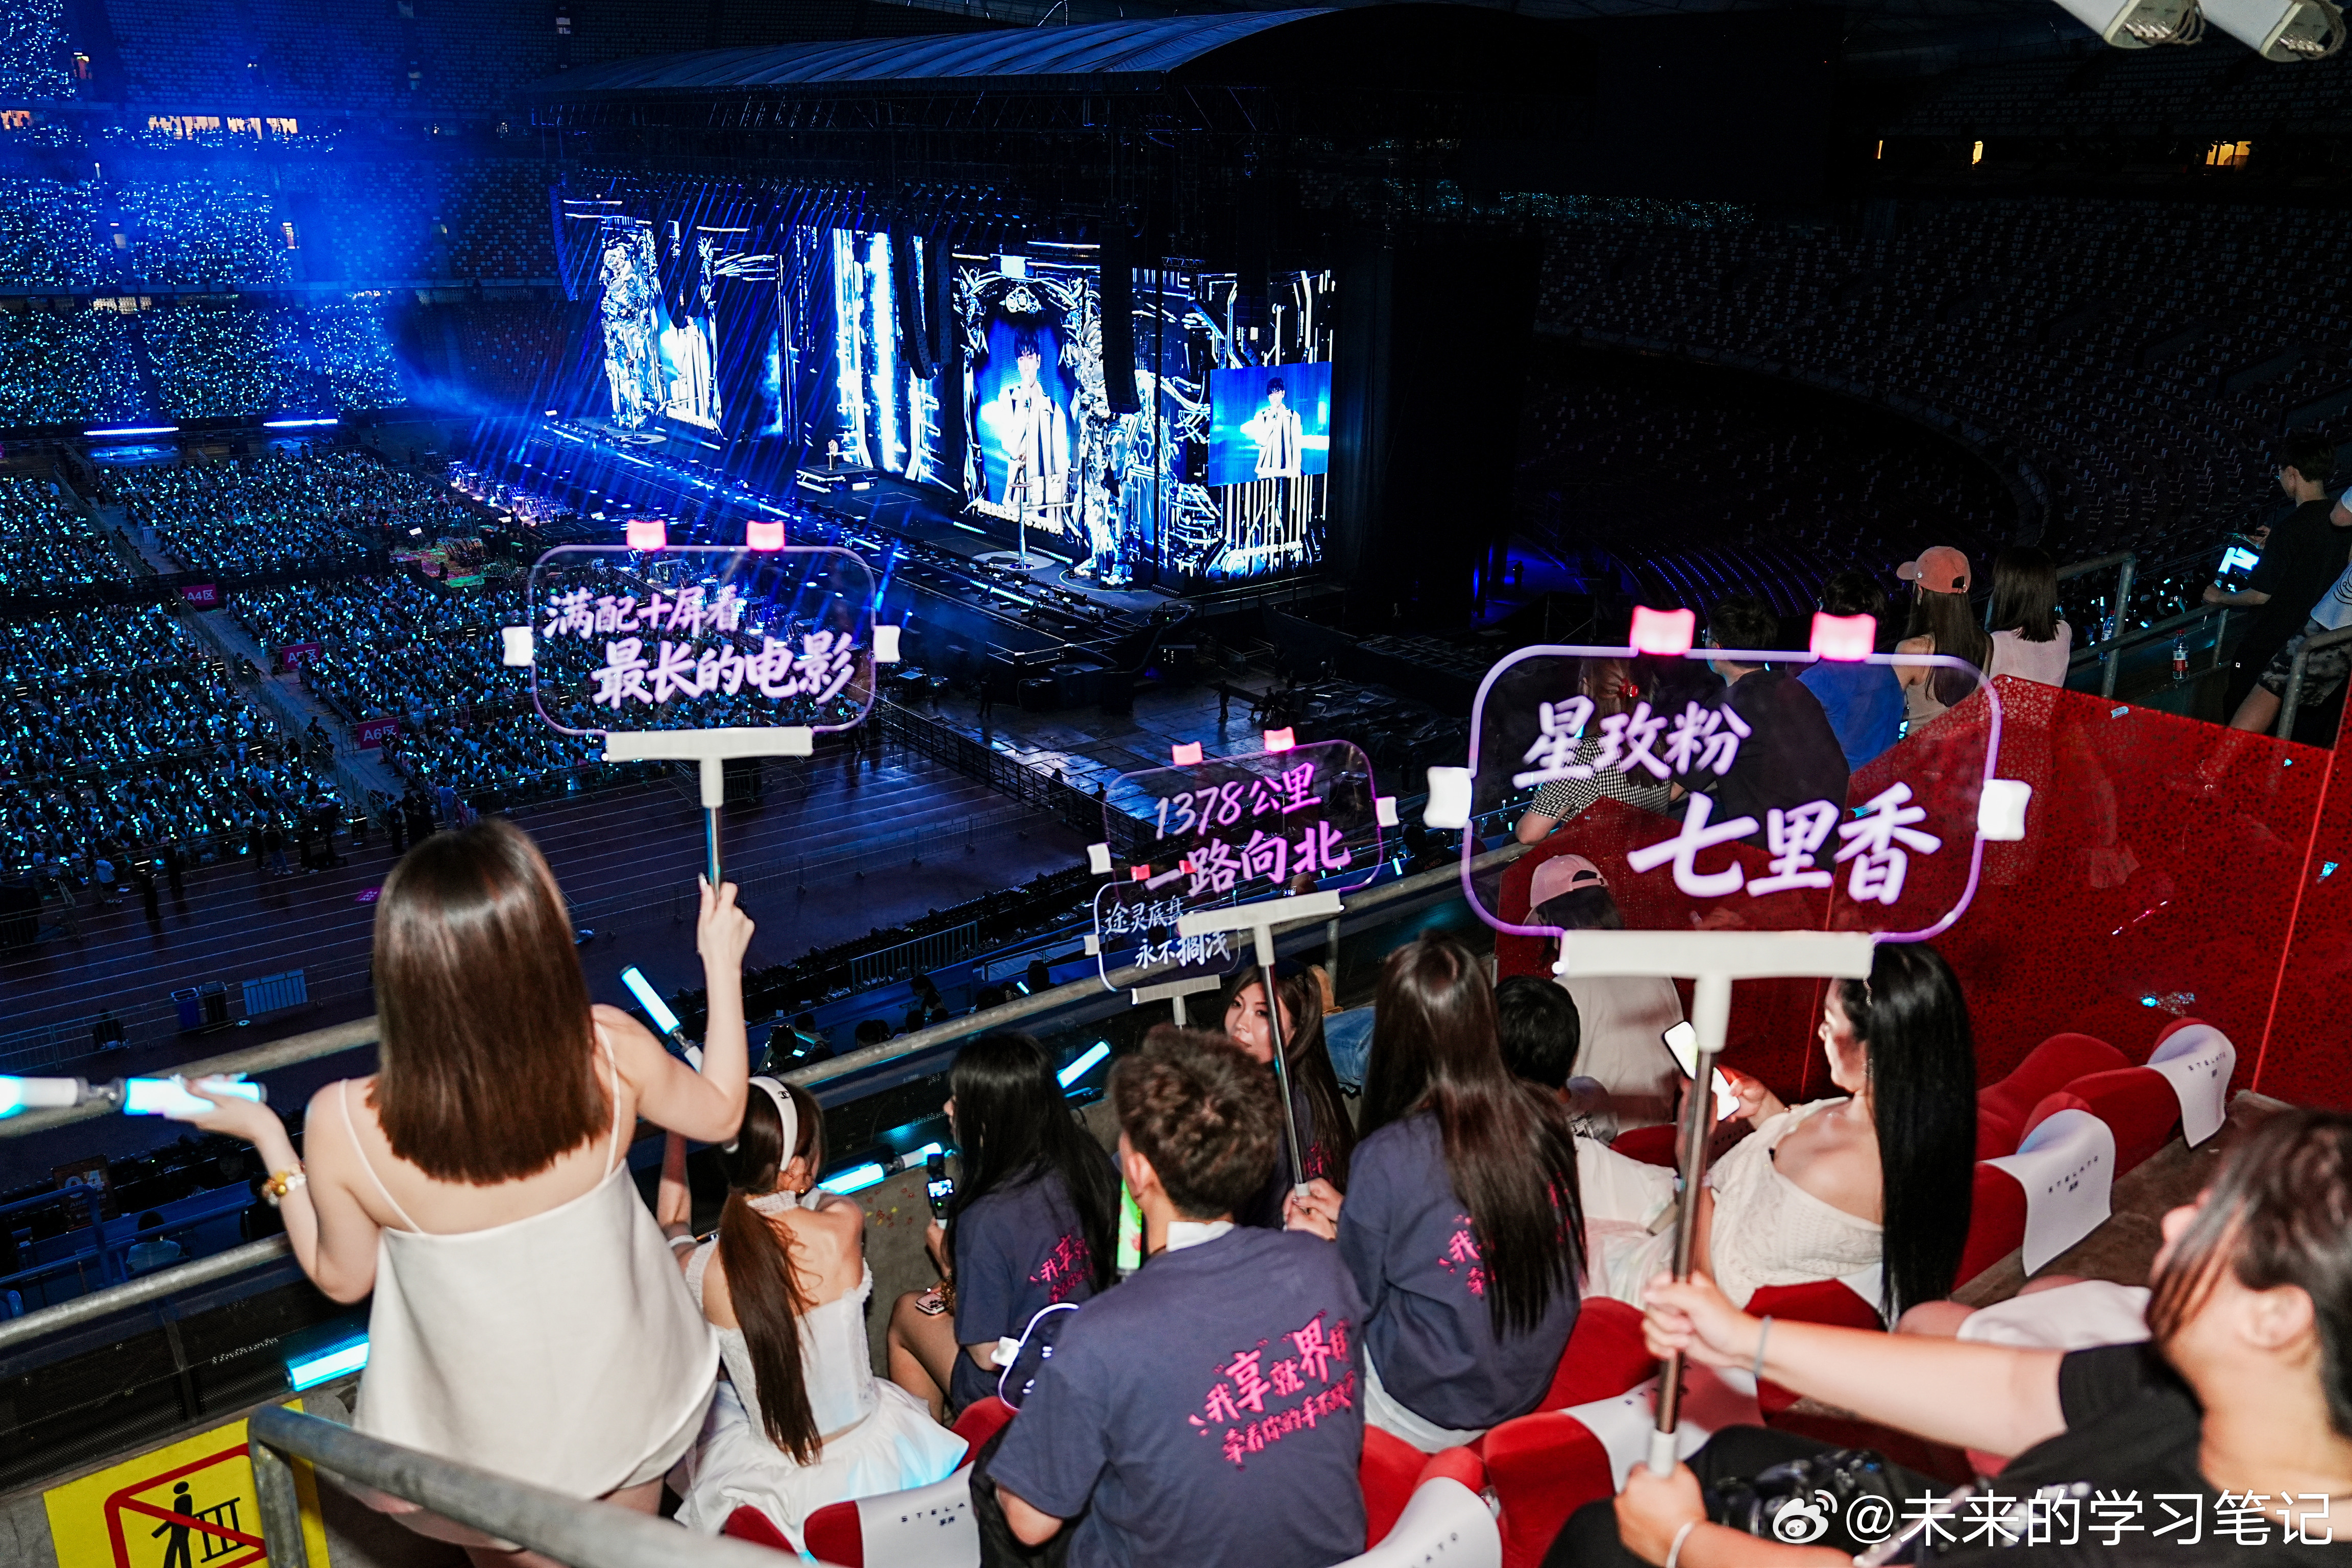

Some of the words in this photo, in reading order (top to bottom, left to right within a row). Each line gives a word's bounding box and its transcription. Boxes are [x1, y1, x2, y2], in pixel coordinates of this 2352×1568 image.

[187, 590, 214, 601] A4区
[543, 585, 740, 639] 满配十屏看
[591, 630, 855, 709] 最长的电影
[1512, 695, 1752, 789] 星玫粉
[1154, 762, 1322, 841] 1378公里
[1145, 821, 1352, 897] 一路向北
[1627, 781, 1942, 905] 七里香
[1105, 895, 1183, 935] 途灵底盘
[1135, 931, 1231, 967] 永不搁浅
